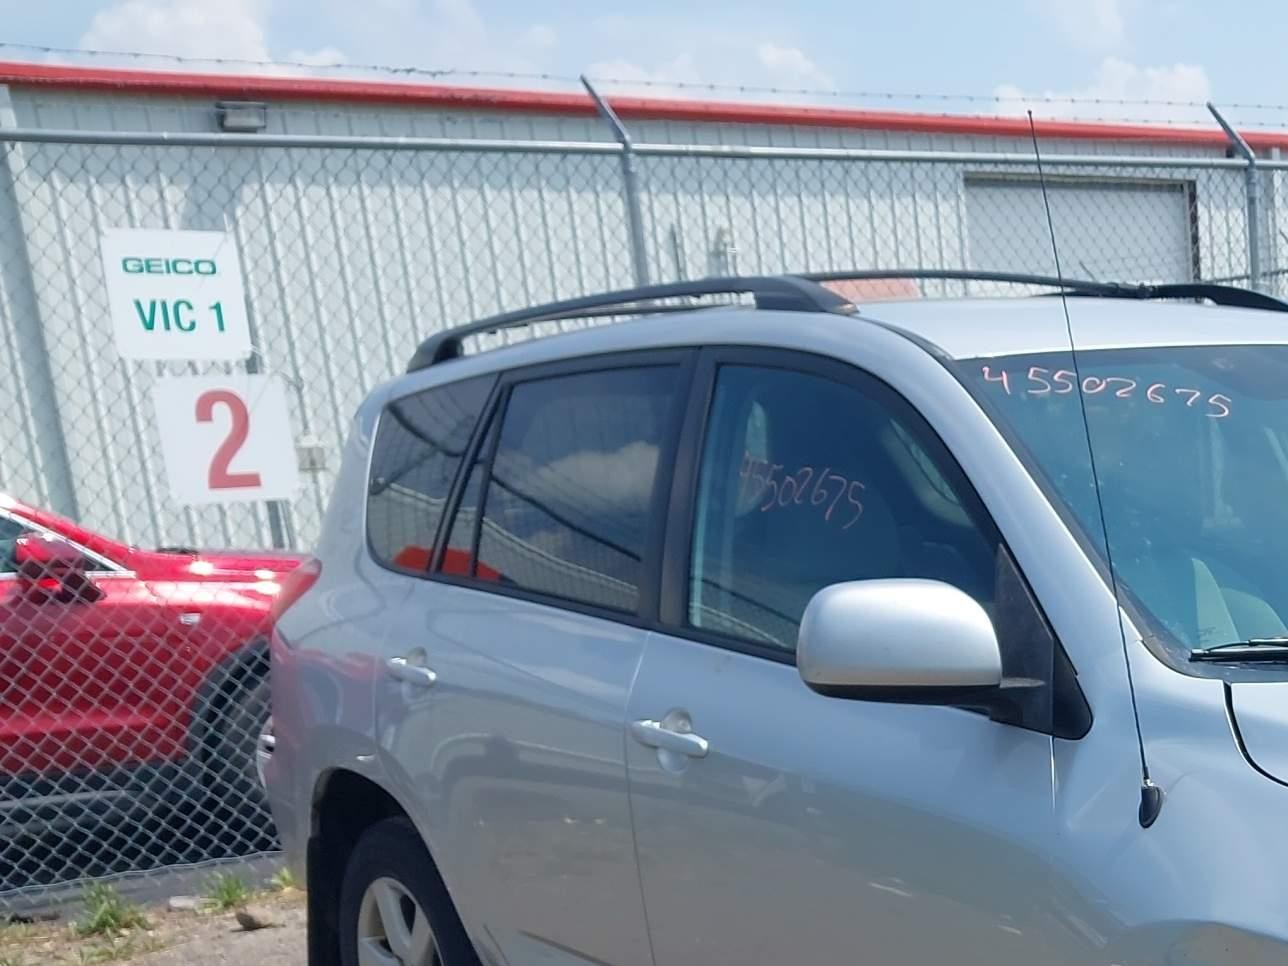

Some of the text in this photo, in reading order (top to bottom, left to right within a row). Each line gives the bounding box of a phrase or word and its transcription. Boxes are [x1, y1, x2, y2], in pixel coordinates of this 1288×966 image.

[121, 256, 218, 276] GEICO
[133, 298, 226, 333] VIC 1
[981, 366, 1232, 418] 45502675
[194, 388, 262, 489] 2
